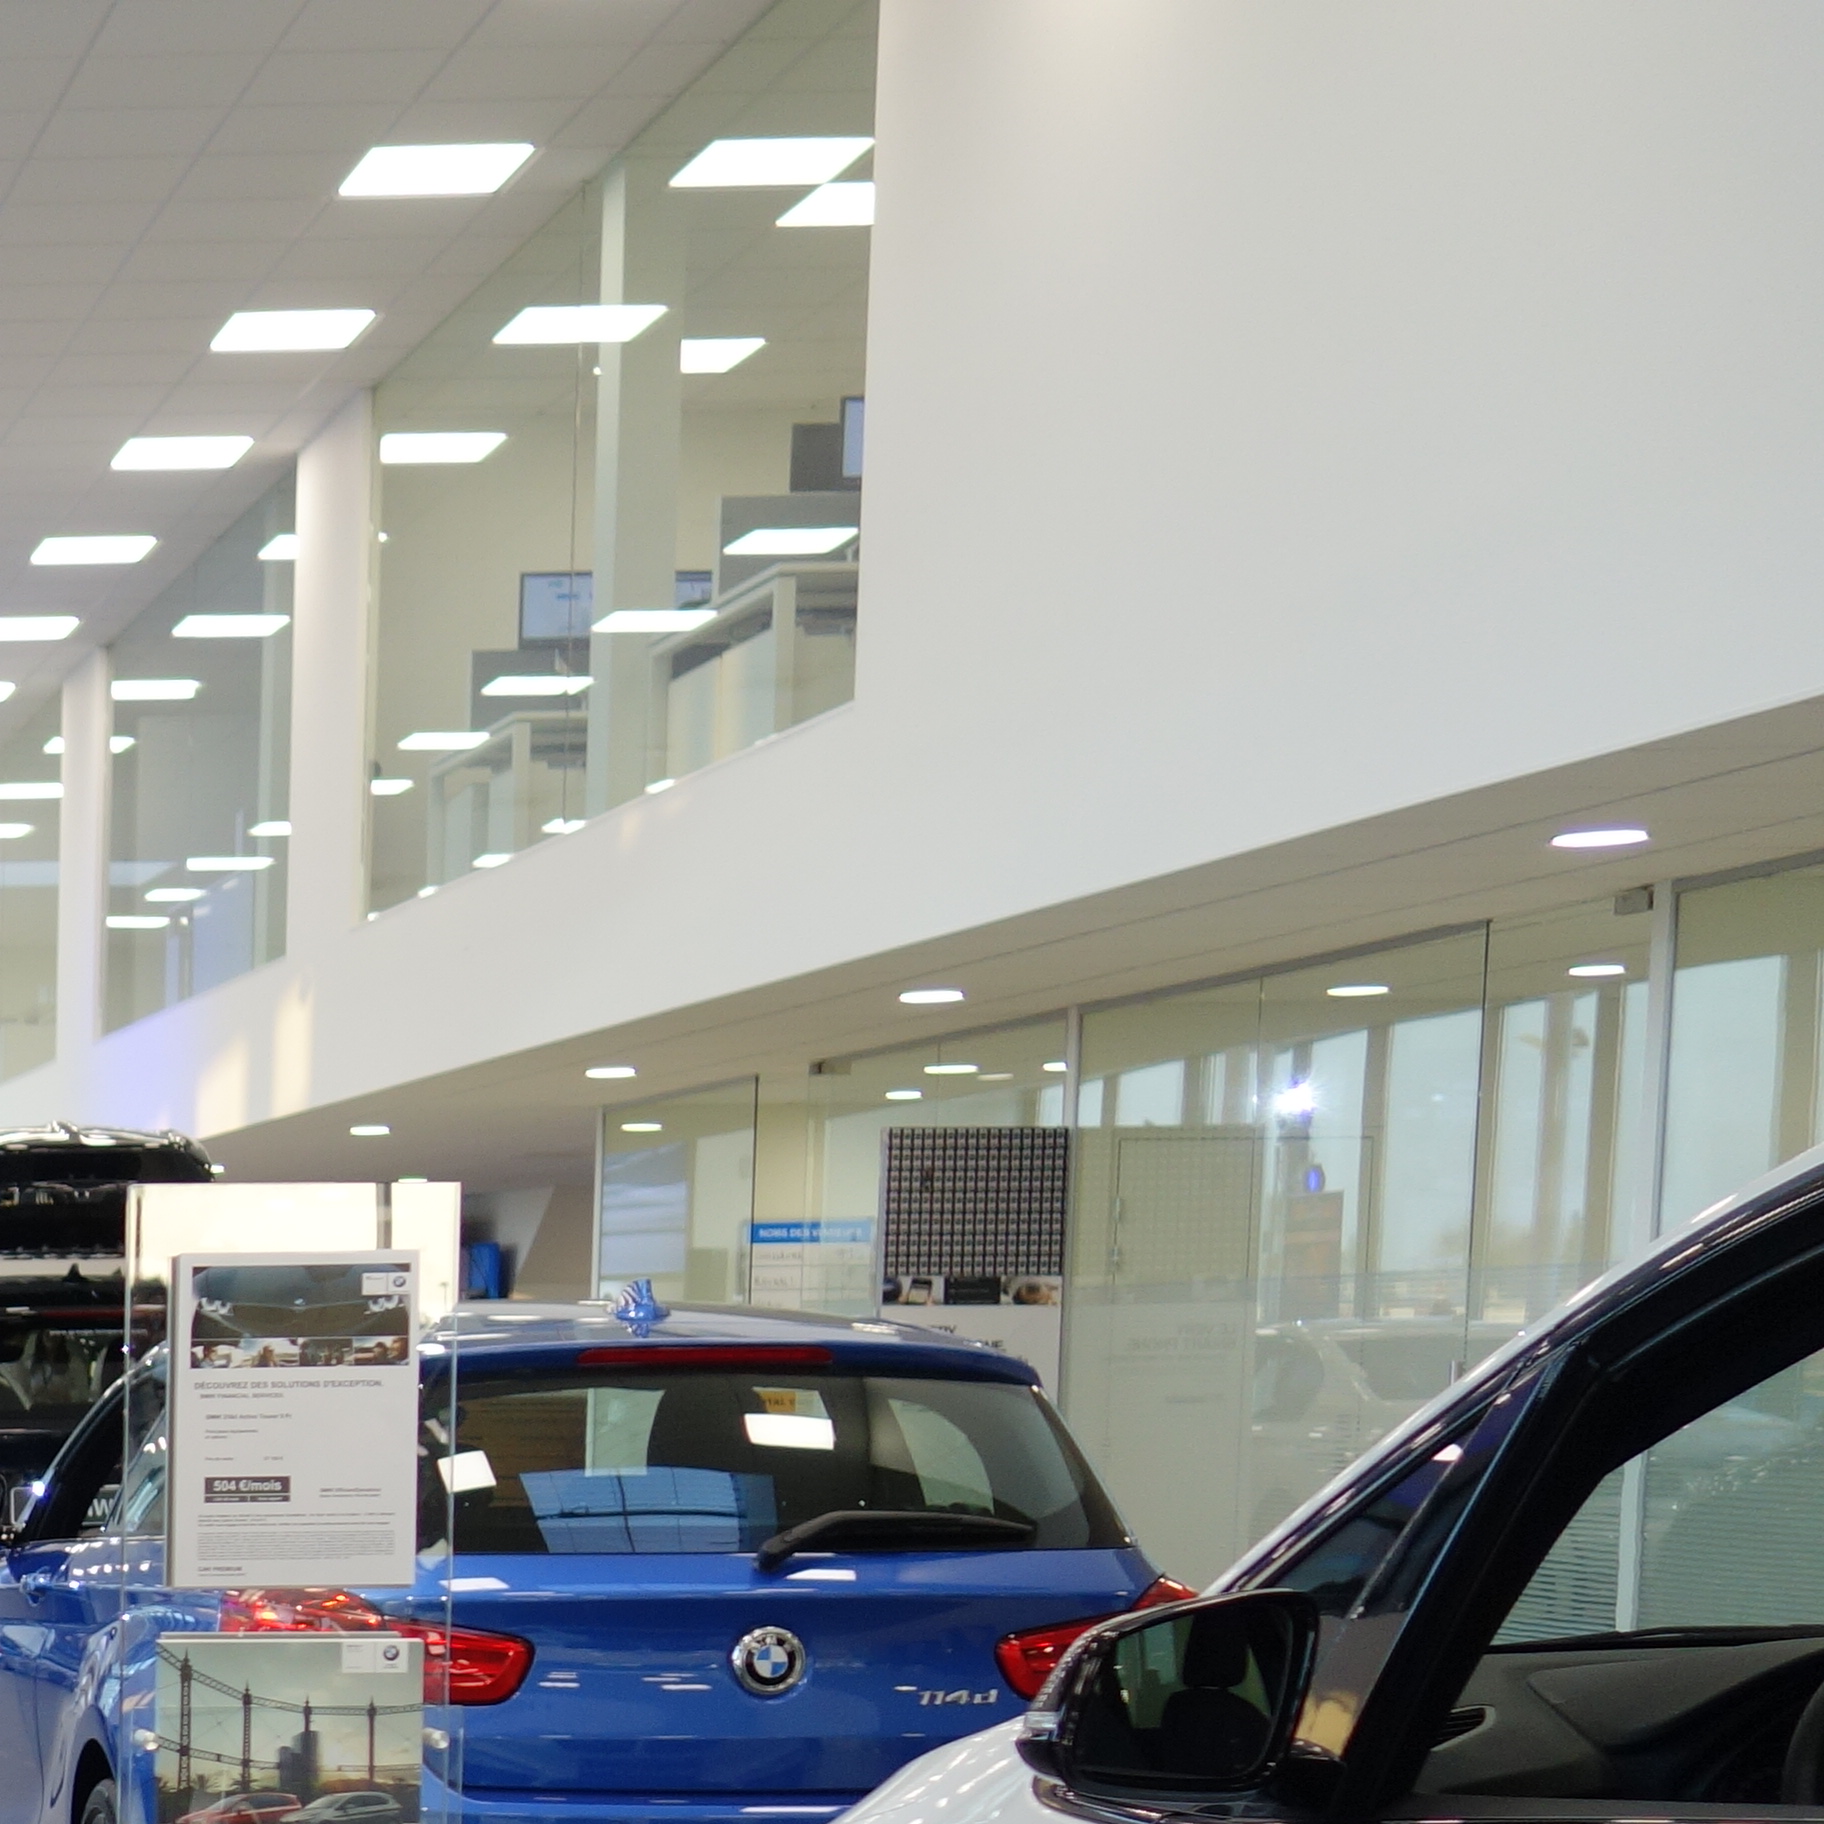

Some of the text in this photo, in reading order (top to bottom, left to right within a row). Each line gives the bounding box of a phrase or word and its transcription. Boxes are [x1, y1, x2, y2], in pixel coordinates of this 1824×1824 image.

[194, 1380, 248, 1390] DÉCOUVREZ
[251, 1381, 269, 1389] DES
[271, 1380, 321, 1389] SOLUTIONS
[212, 1479, 283, 1491] 504 €/mois
[918, 1688, 999, 1706] 114d
